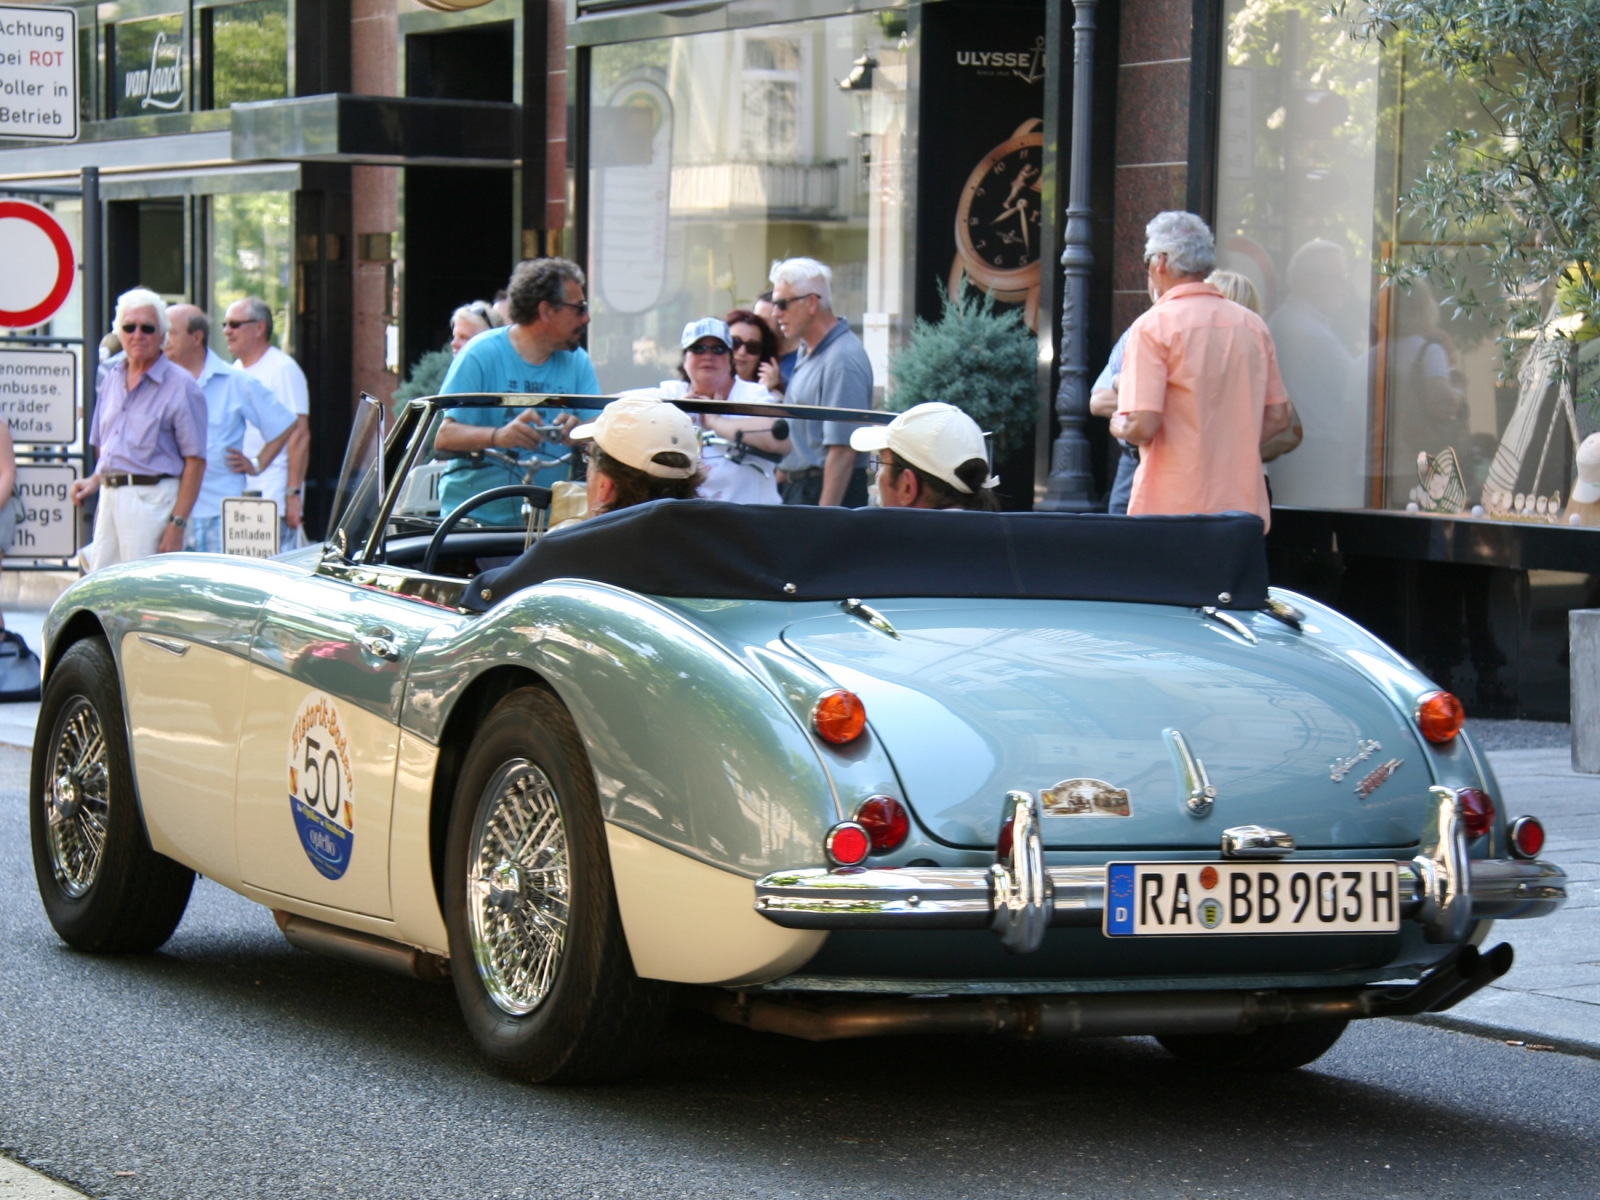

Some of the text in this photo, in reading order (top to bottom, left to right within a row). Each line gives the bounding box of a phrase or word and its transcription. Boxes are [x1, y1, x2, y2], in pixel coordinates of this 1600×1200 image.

[29, 50, 64, 67] ROT
[956, 51, 1031, 67] ULYSSE
[53, 82, 68, 97] in
[125, 69, 149, 98] van
[0, 107, 62, 125] Betrieb
[8, 418, 53, 432] Mofas
[233, 510, 251, 523] Be-
[228, 528, 271, 540] Entladen
[303, 735, 341, 819] 50
[1140, 872, 1192, 926] RA
[1115, 906, 1128, 922] D
